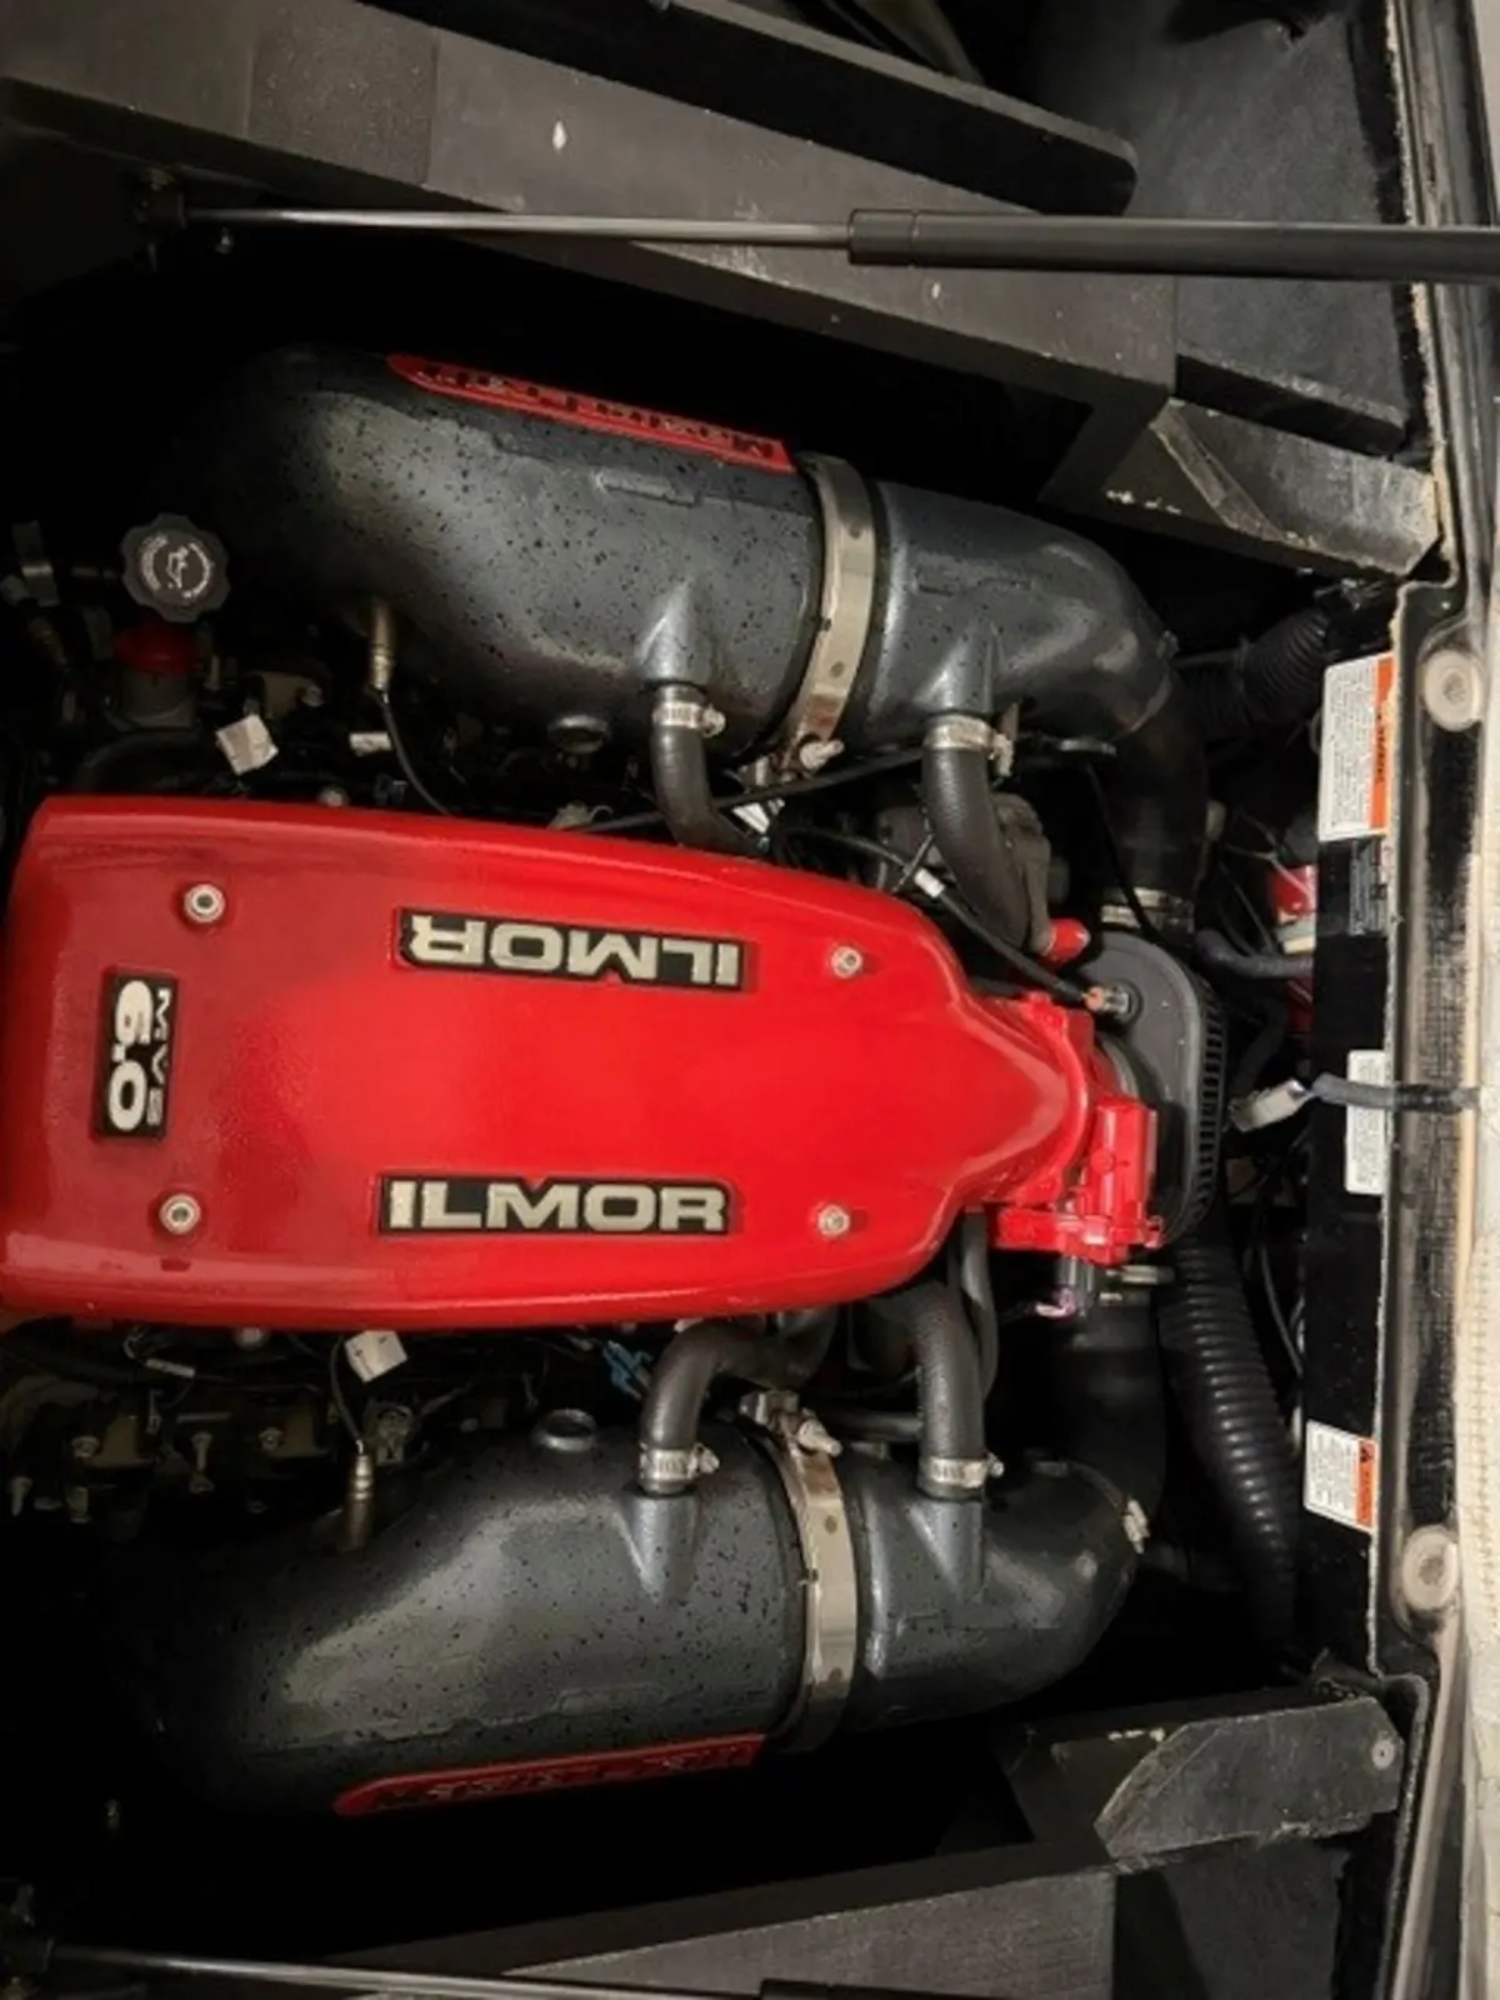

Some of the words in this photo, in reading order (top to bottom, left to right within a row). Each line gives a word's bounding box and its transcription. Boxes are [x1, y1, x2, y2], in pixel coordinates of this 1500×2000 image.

[409, 915, 740, 985] ILMOR
[108, 980, 154, 1132] 6.0
[389, 1181, 726, 1231] ILMOR
